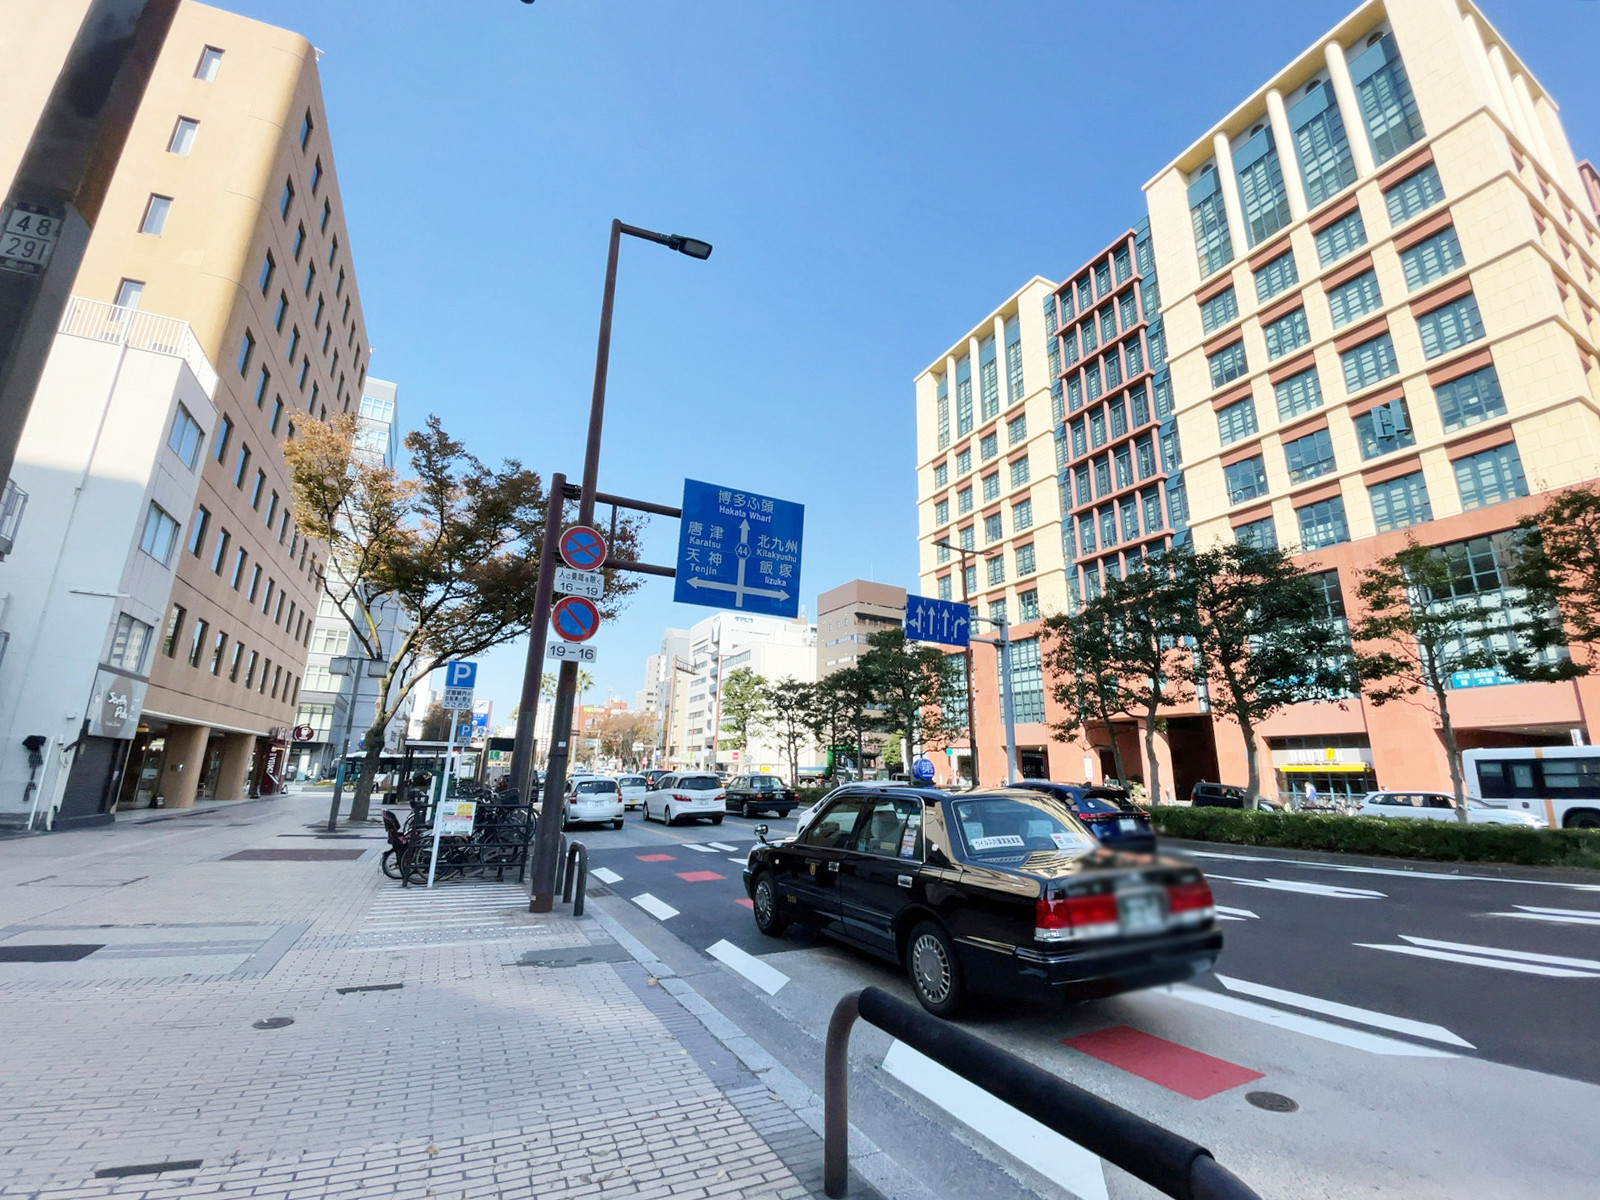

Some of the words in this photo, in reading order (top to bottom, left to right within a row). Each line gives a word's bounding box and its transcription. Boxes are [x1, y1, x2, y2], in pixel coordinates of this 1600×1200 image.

[16, 215, 52, 236] 48
[5, 237, 47, 260] 291
[718, 489, 774, 514] 博多ふ頭
[719, 505, 747, 518] Hakata
[749, 511, 772, 523] Wharf
[688, 521, 724, 540] 唐津
[689, 536, 721, 549] Karatsu
[737, 547, 748, 555] 44
[757, 534, 798, 554] 北九州
[685, 547, 723, 567] 天神
[756, 548, 797, 563] Kitakyushu
[690, 563, 717, 575] Tenjin
[760, 560, 793, 578] 飯塚
[764, 576, 787, 587] Iizuka
[453, 663, 471, 685] P
[461, 725, 471, 736] P
